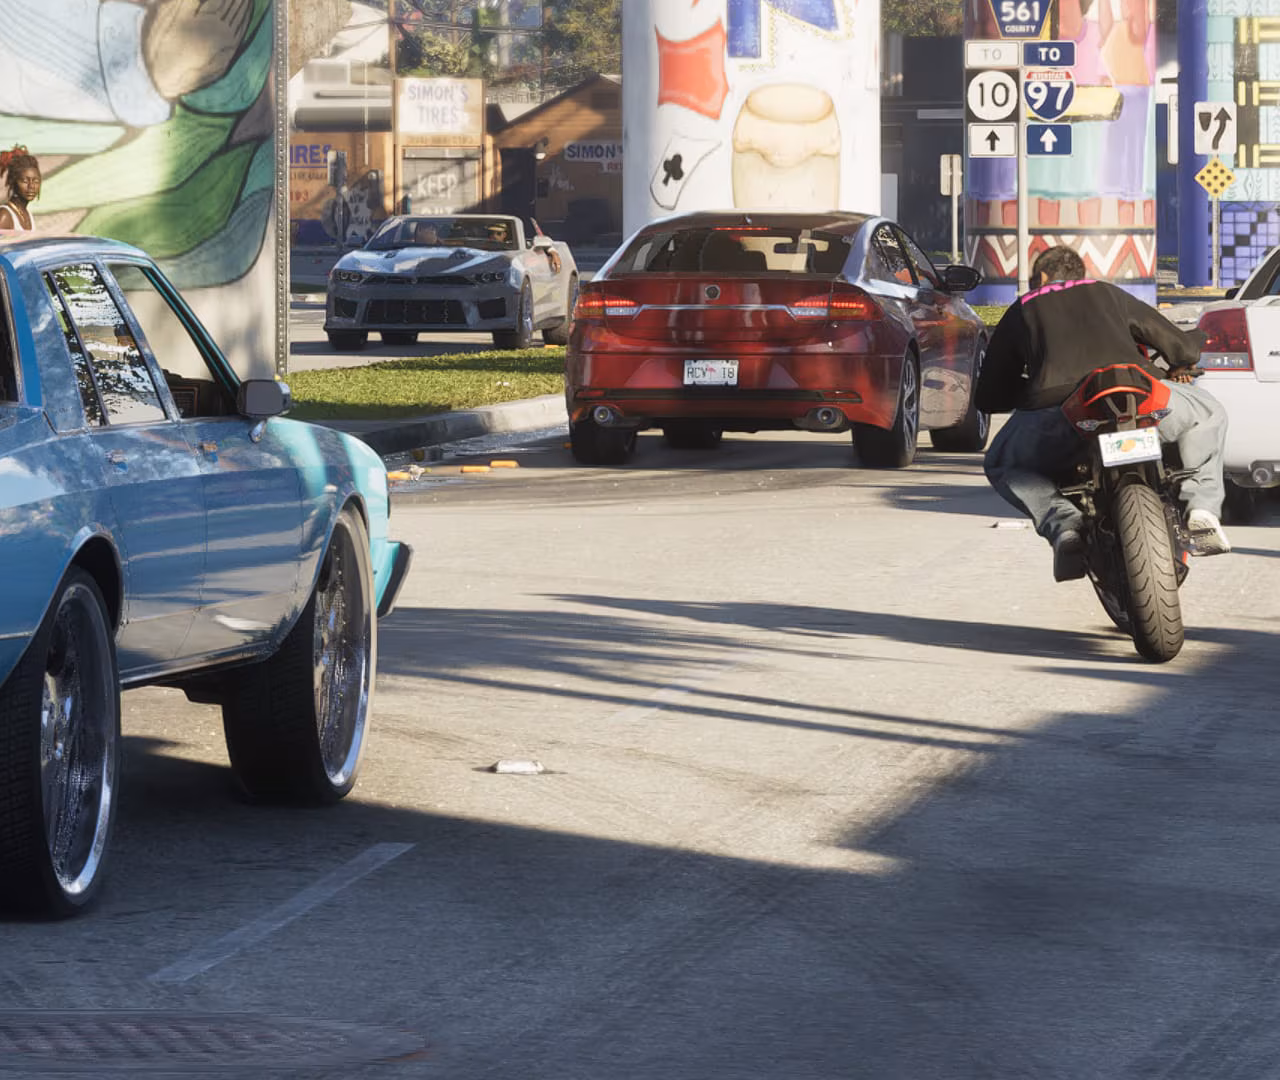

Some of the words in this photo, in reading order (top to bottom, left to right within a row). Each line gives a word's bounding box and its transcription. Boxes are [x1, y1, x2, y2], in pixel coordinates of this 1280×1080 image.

[1001, 1, 1040, 22] 561
[1005, 25, 1036, 33] COUNTY
[983, 48, 1002, 60] TO
[1038, 47, 1061, 61] TO
[408, 84, 469, 103] SIMON'S
[979, 82, 1009, 108] 10
[1027, 82, 1071, 110] 97
[416, 105, 459, 126] TIRES
[290, 143, 332, 165] IRES
[567, 144, 623, 159] SIMON'
[417, 173, 458, 199] KEEP
